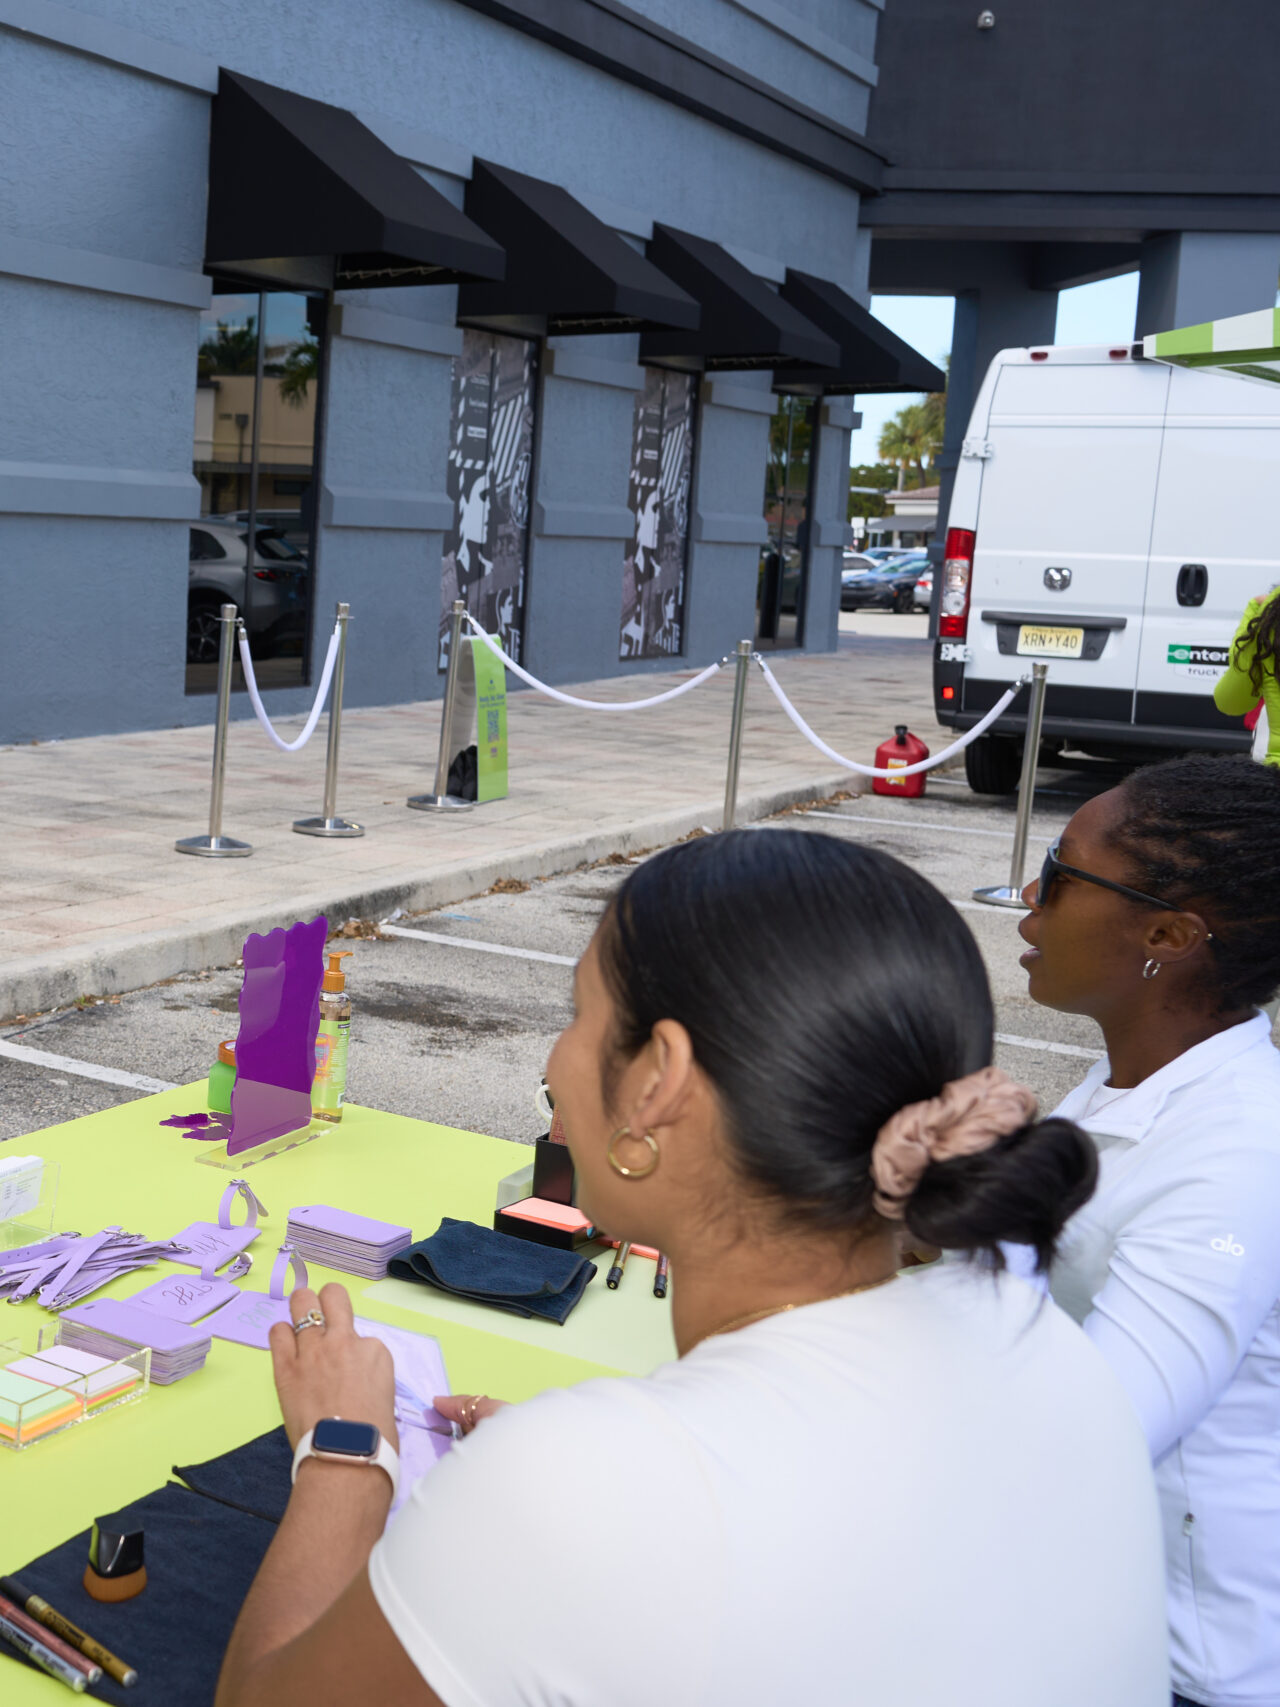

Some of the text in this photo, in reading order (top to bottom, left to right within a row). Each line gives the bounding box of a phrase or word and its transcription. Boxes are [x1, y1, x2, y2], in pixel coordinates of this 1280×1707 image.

[1023, 632, 1046, 647] XRN
[1188, 667, 1218, 676] truck
[1210, 1234, 1245, 1257] alo
